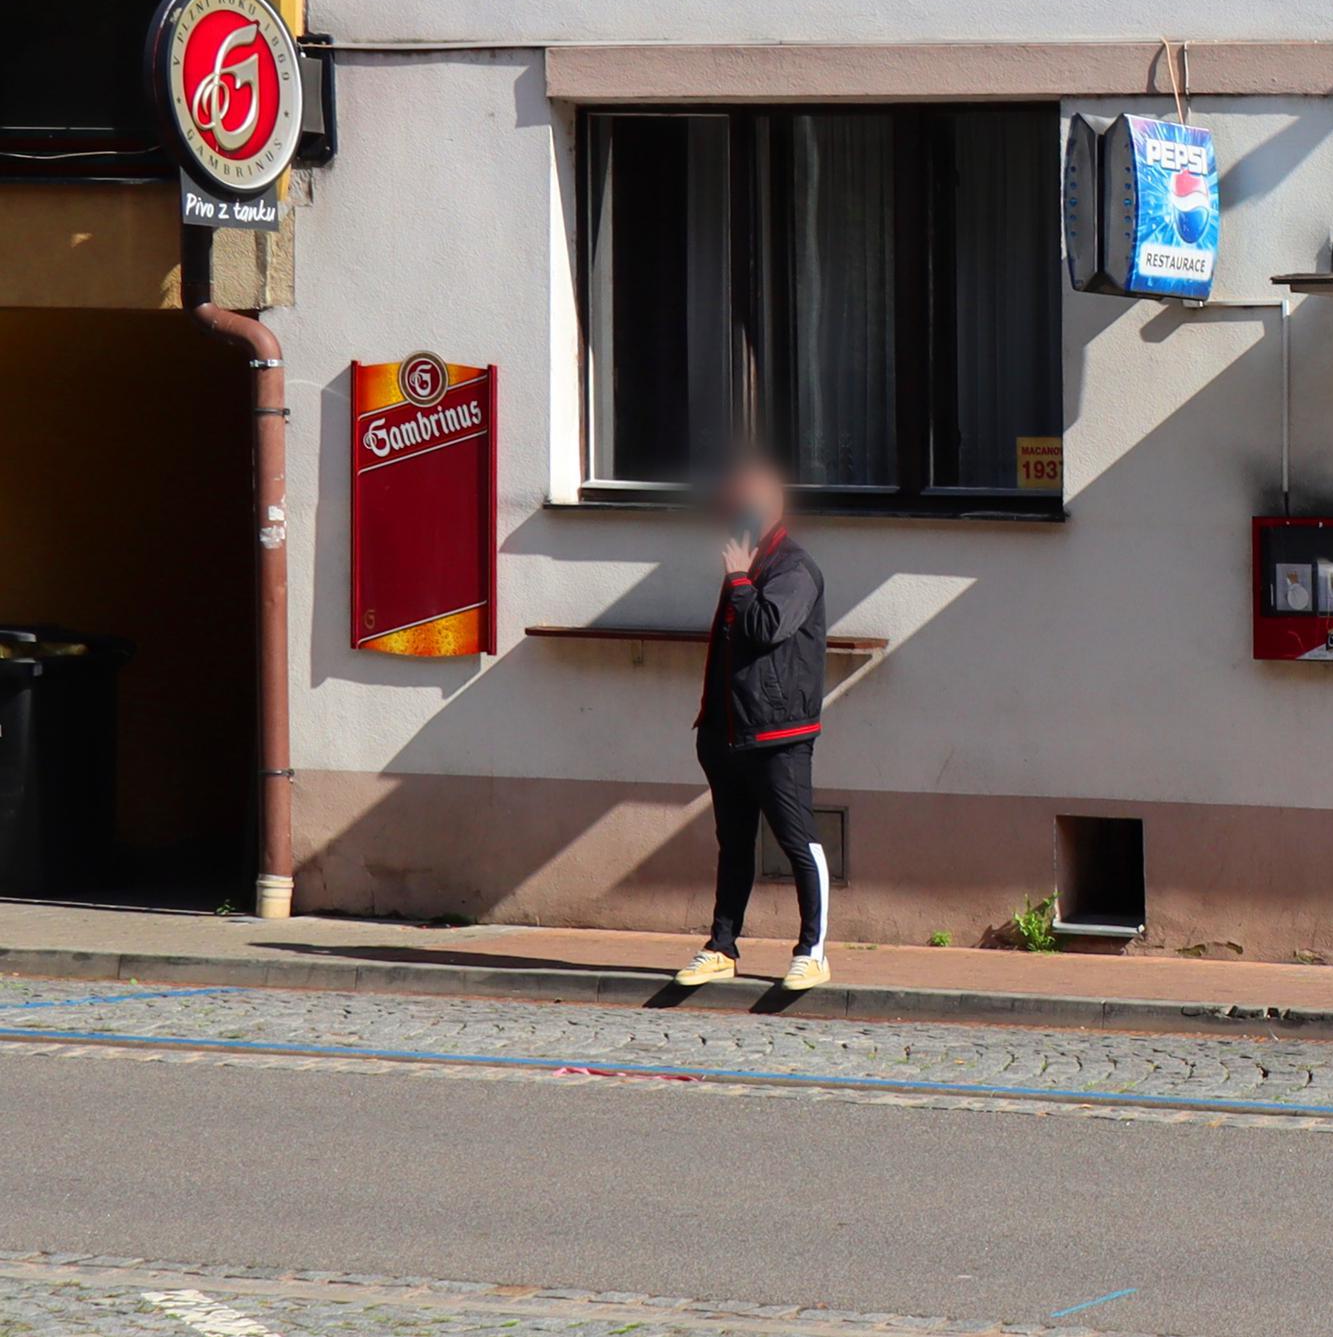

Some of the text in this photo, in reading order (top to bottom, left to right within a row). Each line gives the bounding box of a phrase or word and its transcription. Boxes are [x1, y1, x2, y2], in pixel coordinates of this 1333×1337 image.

[1145, 138, 1208, 176] PEPSI
[185, 193, 277, 223] Pivo z tanku
[1146, 252, 1206, 274] RESTAURACE
[362, 399, 482, 458] Gambrinus
